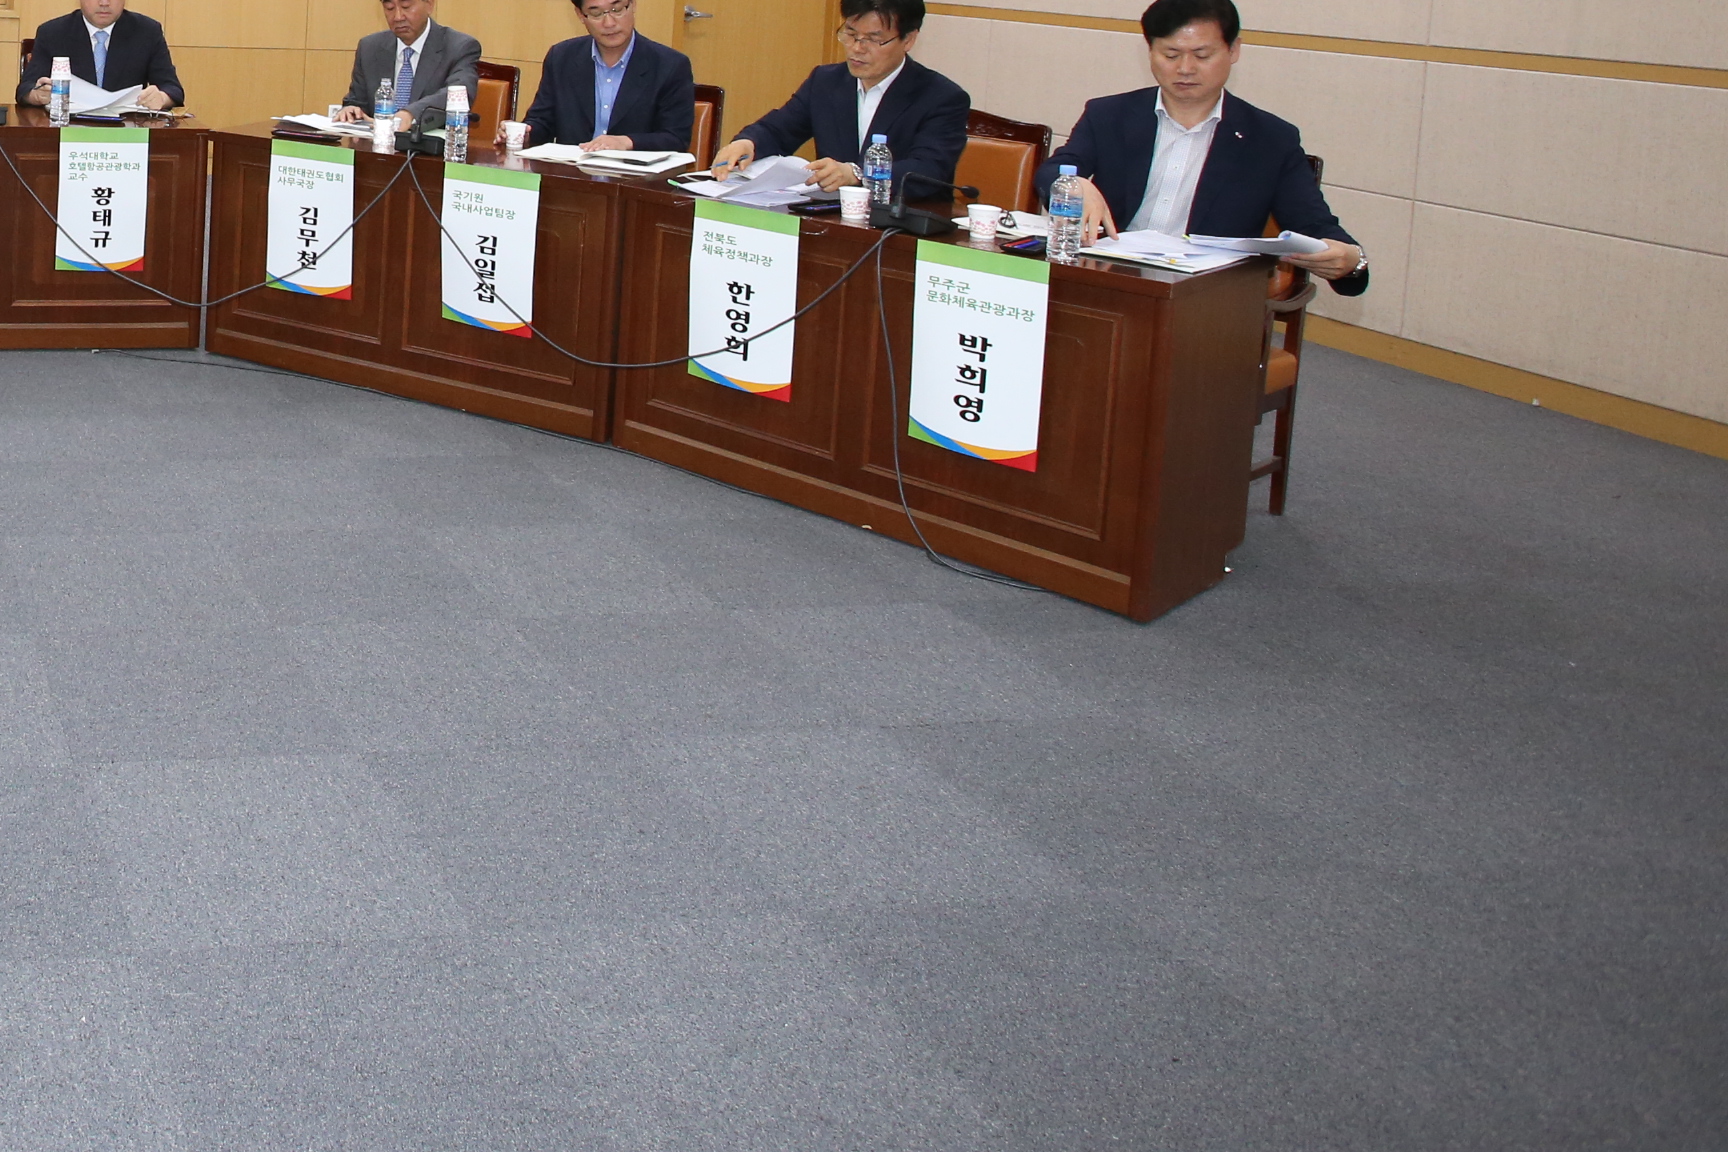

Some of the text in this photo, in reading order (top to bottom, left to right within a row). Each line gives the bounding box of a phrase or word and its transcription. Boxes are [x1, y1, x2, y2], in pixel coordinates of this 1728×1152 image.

[68, 151, 119, 161] 우석대학교
[68, 161, 141, 171] 호텔항공관광학과
[67, 172, 89, 182] 교수
[277, 175, 315, 190] 사무국장
[278, 164, 345, 184] 대한태권도협회
[451, 189, 484, 204] 국기원
[90, 186, 116, 248] 황태규
[451, 201, 517, 221] 국내사업팀장
[297, 206, 319, 271] 김무천
[703, 230, 738, 246] 전북도
[701, 243, 774, 268] 체육정책과장
[473, 234, 498, 304] 김일섭
[927, 275, 971, 295] 무주군
[926, 290, 1036, 323] 문화체육관광과장
[953, 332, 993, 423] 박희영
